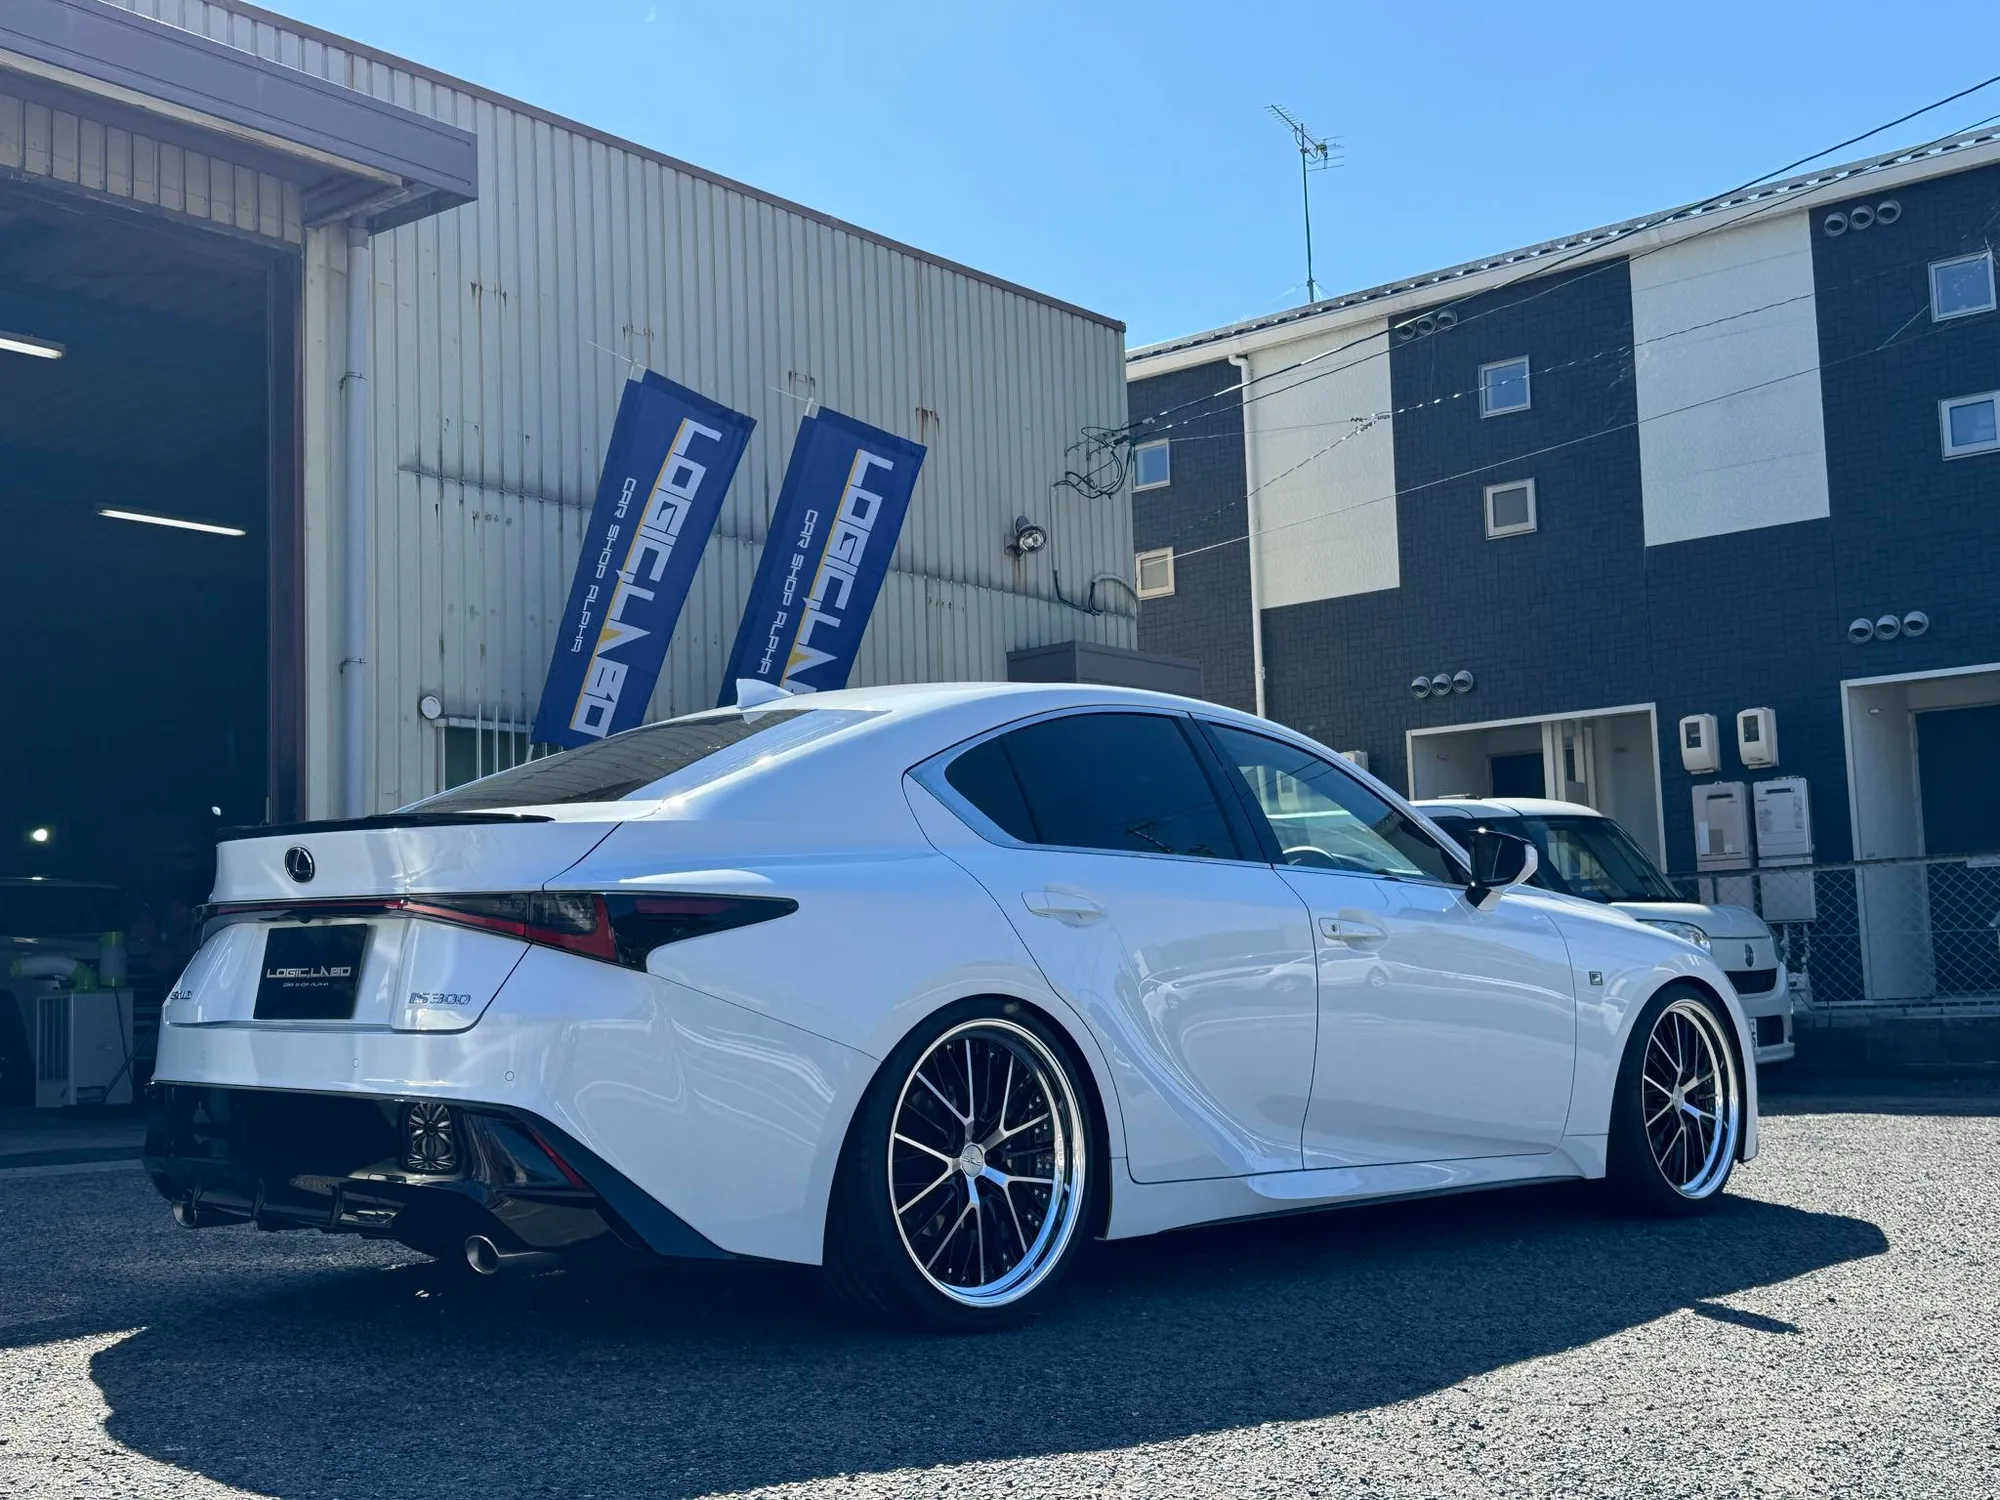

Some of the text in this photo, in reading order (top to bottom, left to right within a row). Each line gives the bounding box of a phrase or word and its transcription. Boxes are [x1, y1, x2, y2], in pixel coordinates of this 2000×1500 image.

[570, 477, 637, 652] CAR SHOP ALPHA
[758, 509, 818, 675] CAR SHOP ALPHA
